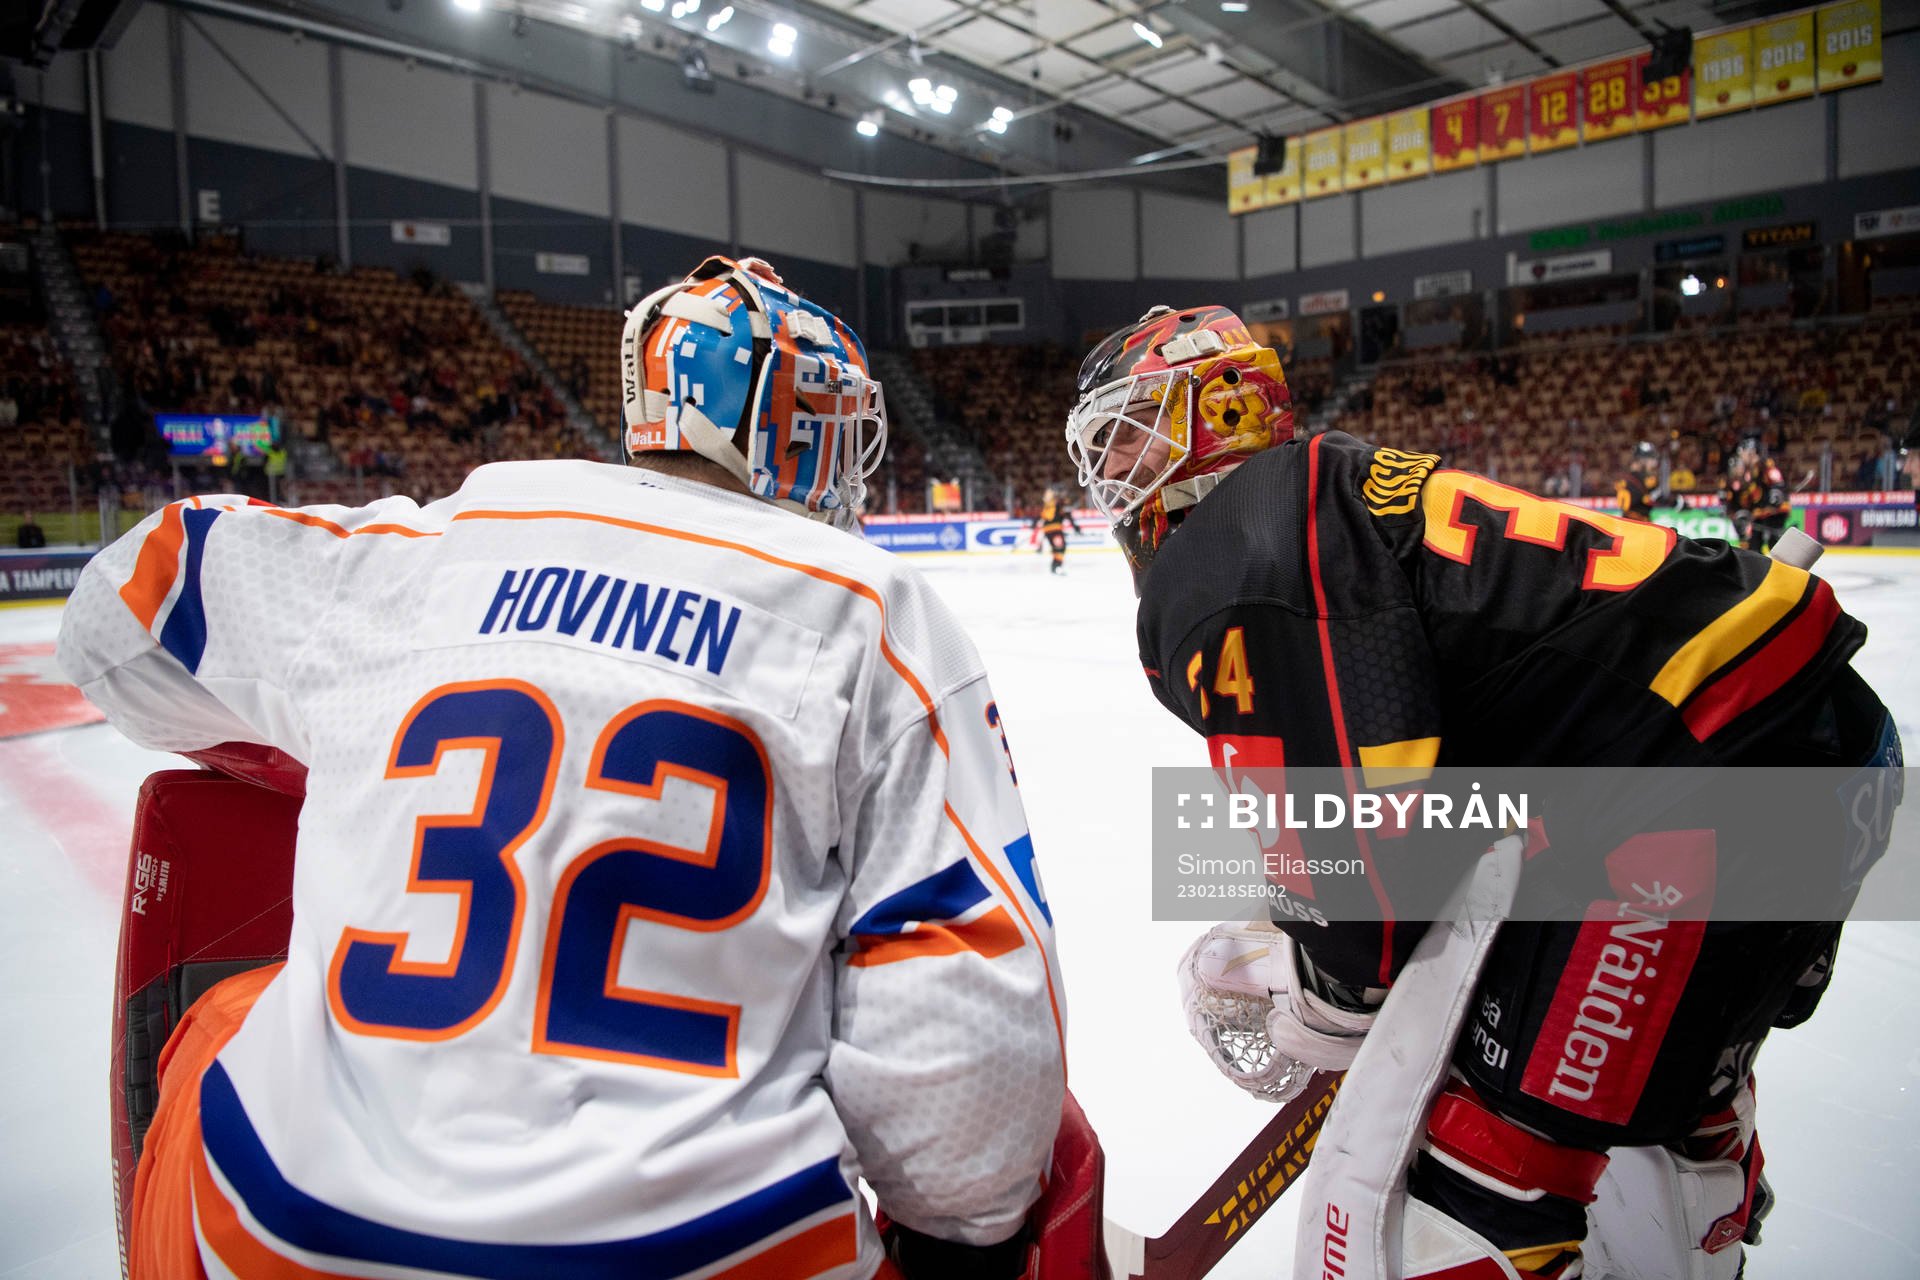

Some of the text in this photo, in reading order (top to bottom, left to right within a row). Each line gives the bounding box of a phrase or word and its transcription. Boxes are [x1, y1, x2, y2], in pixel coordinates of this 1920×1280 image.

[1760, 41, 1806, 70] 2012
[1826, 25, 1873, 55] 2015
[1540, 91, 1568, 126] 12
[1590, 76, 1626, 114] 28
[1446, 113, 1463, 146] 4
[1493, 103, 1511, 136] 7
[198, 190, 221, 223] E
[1748, 224, 1812, 245] TITAN
[1860, 509, 1918, 528] DOWNLOAD
[478, 566, 743, 677] HOVINEN
[158, 860, 170, 895] SMITH
[327, 678, 775, 1080] 32
